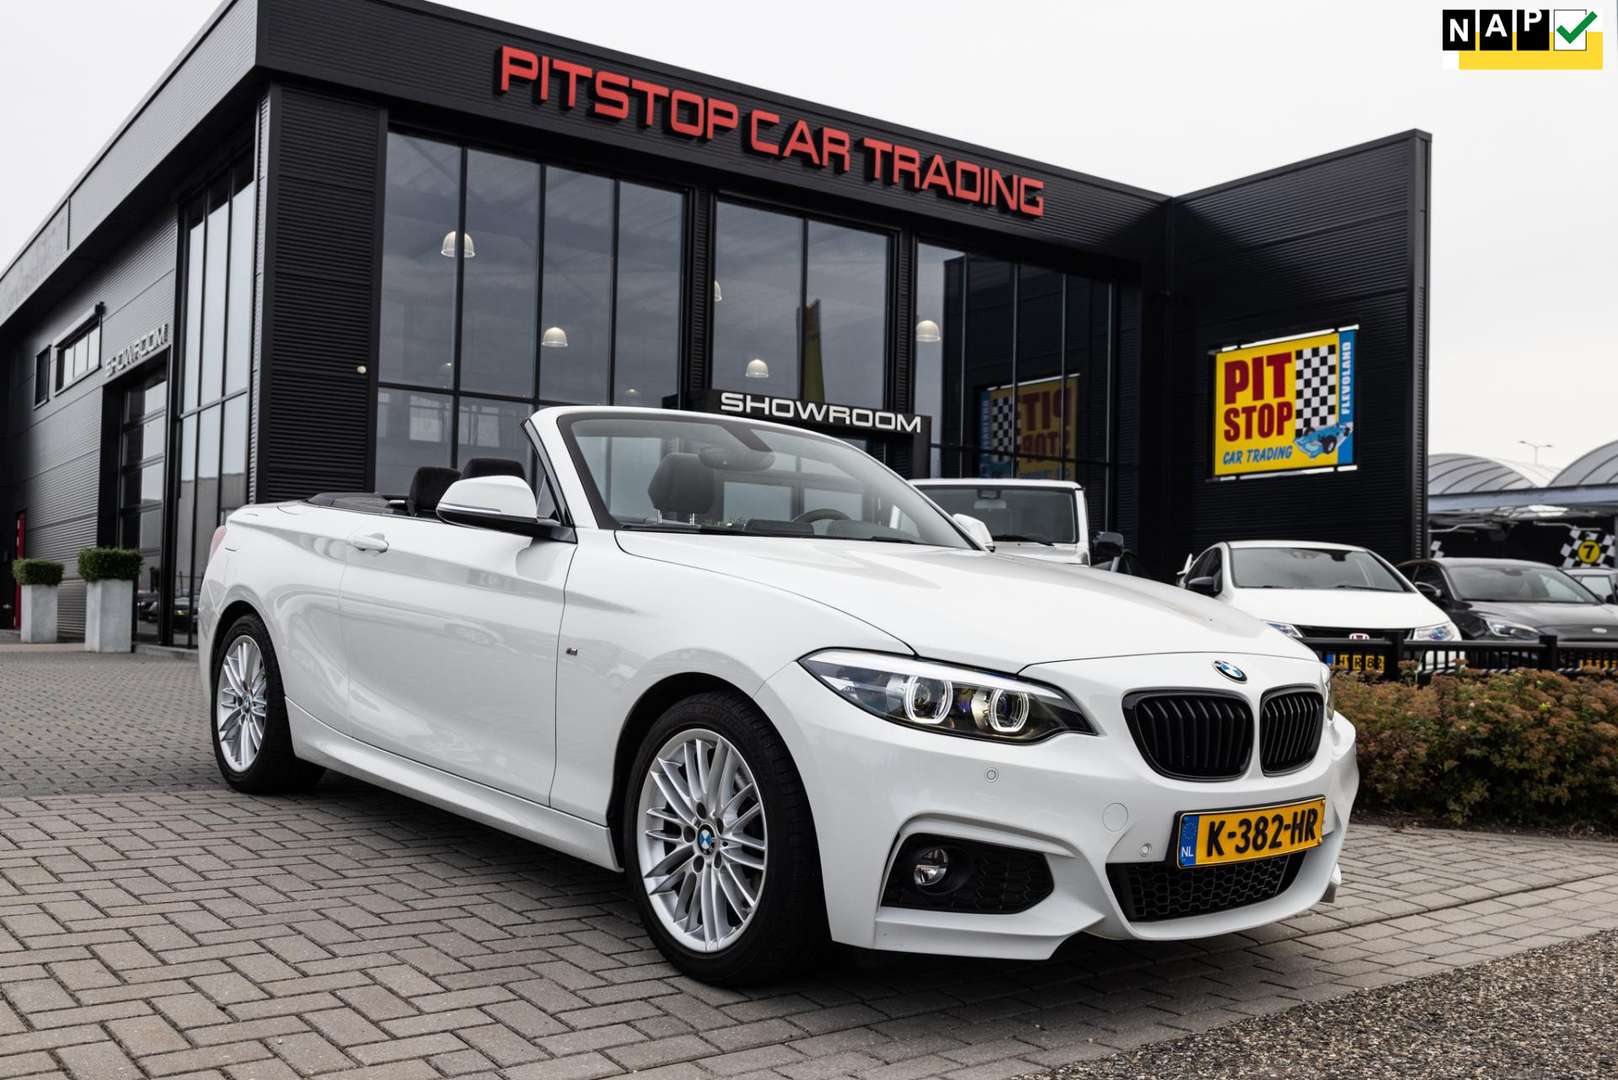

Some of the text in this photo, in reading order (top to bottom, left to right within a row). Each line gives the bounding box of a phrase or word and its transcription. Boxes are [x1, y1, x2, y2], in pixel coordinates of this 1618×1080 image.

[501, 45, 1045, 217] PITSTOP CAR TRADING
[1223, 351, 1293, 405] PIT
[1341, 341, 1351, 415] FLEVOLAND
[720, 391, 922, 433] SHOWROOM
[1223, 400, 1294, 443] STOP
[1223, 445, 1293, 465] CAR TRADING
[1583, 544, 1595, 560] 7
[1181, 845, 1194, 857] NL
[1206, 808, 1318, 857] K-382-HR
